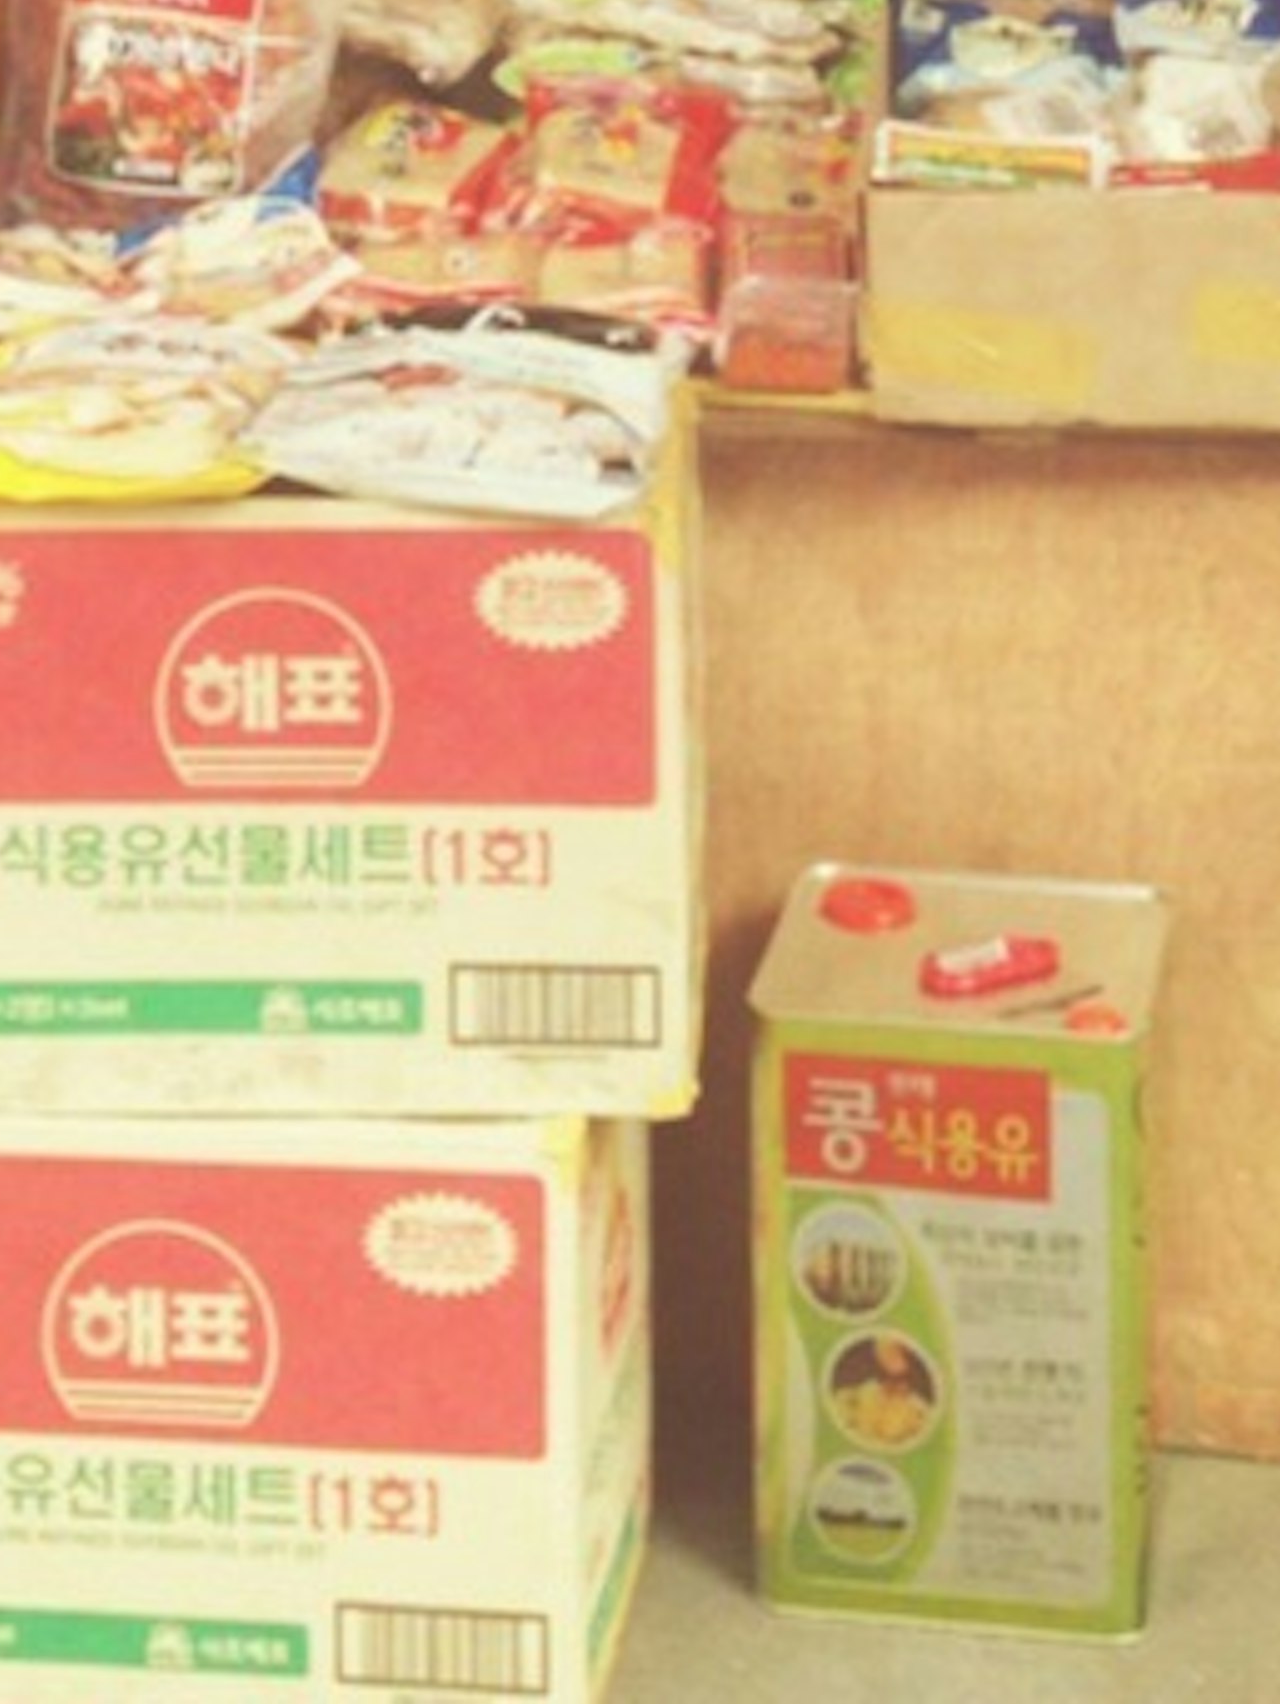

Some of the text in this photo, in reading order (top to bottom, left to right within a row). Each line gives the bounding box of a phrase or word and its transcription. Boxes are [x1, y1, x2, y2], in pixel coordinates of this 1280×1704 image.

[182, 649, 363, 733] 해표
[802, 1076, 1039, 1185] 콩 식용유
[67, 1284, 252, 1369] 해표
